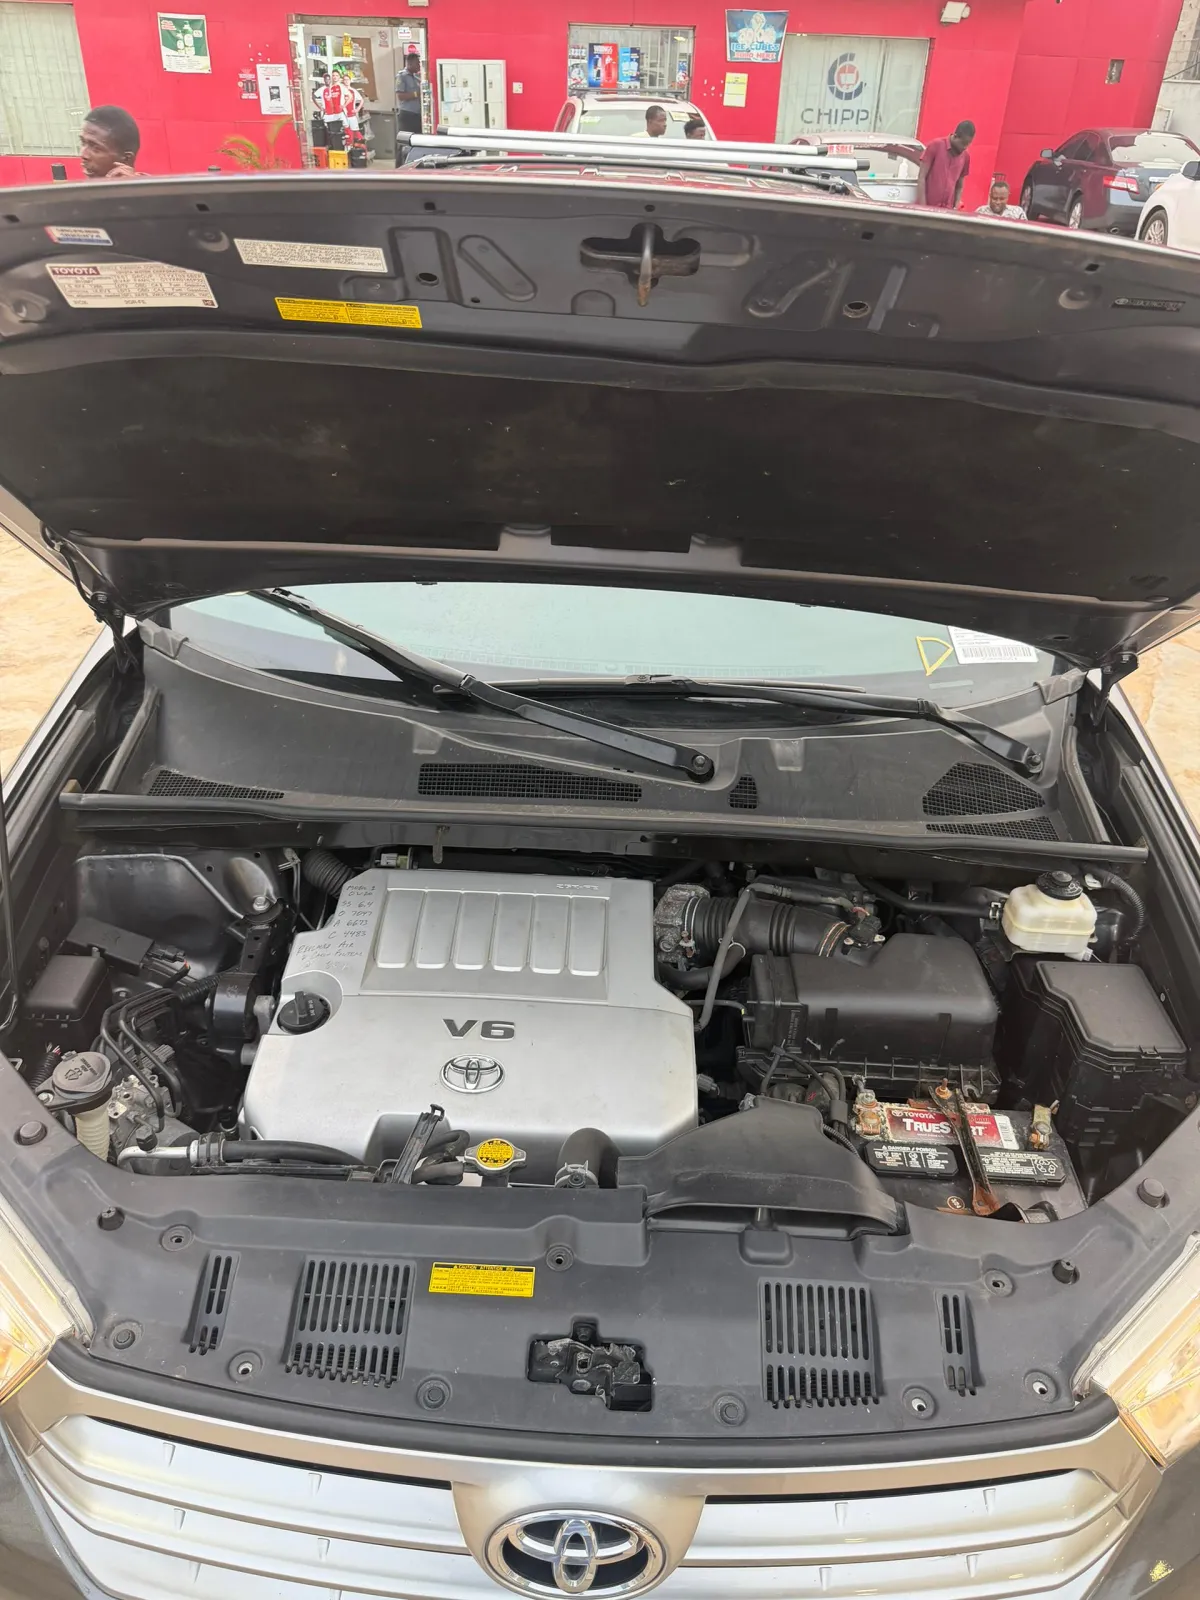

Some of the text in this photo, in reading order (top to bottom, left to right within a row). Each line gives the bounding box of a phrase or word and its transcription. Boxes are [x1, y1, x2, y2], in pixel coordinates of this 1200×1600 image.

[800, 108, 882, 125] CHIPP
[53, 267, 98, 275] TOYOTA
[441, 1018, 516, 1041] V6
[903, 1111, 935, 1119] TOYOTA
[902, 1118, 985, 1136] TRUESRT
